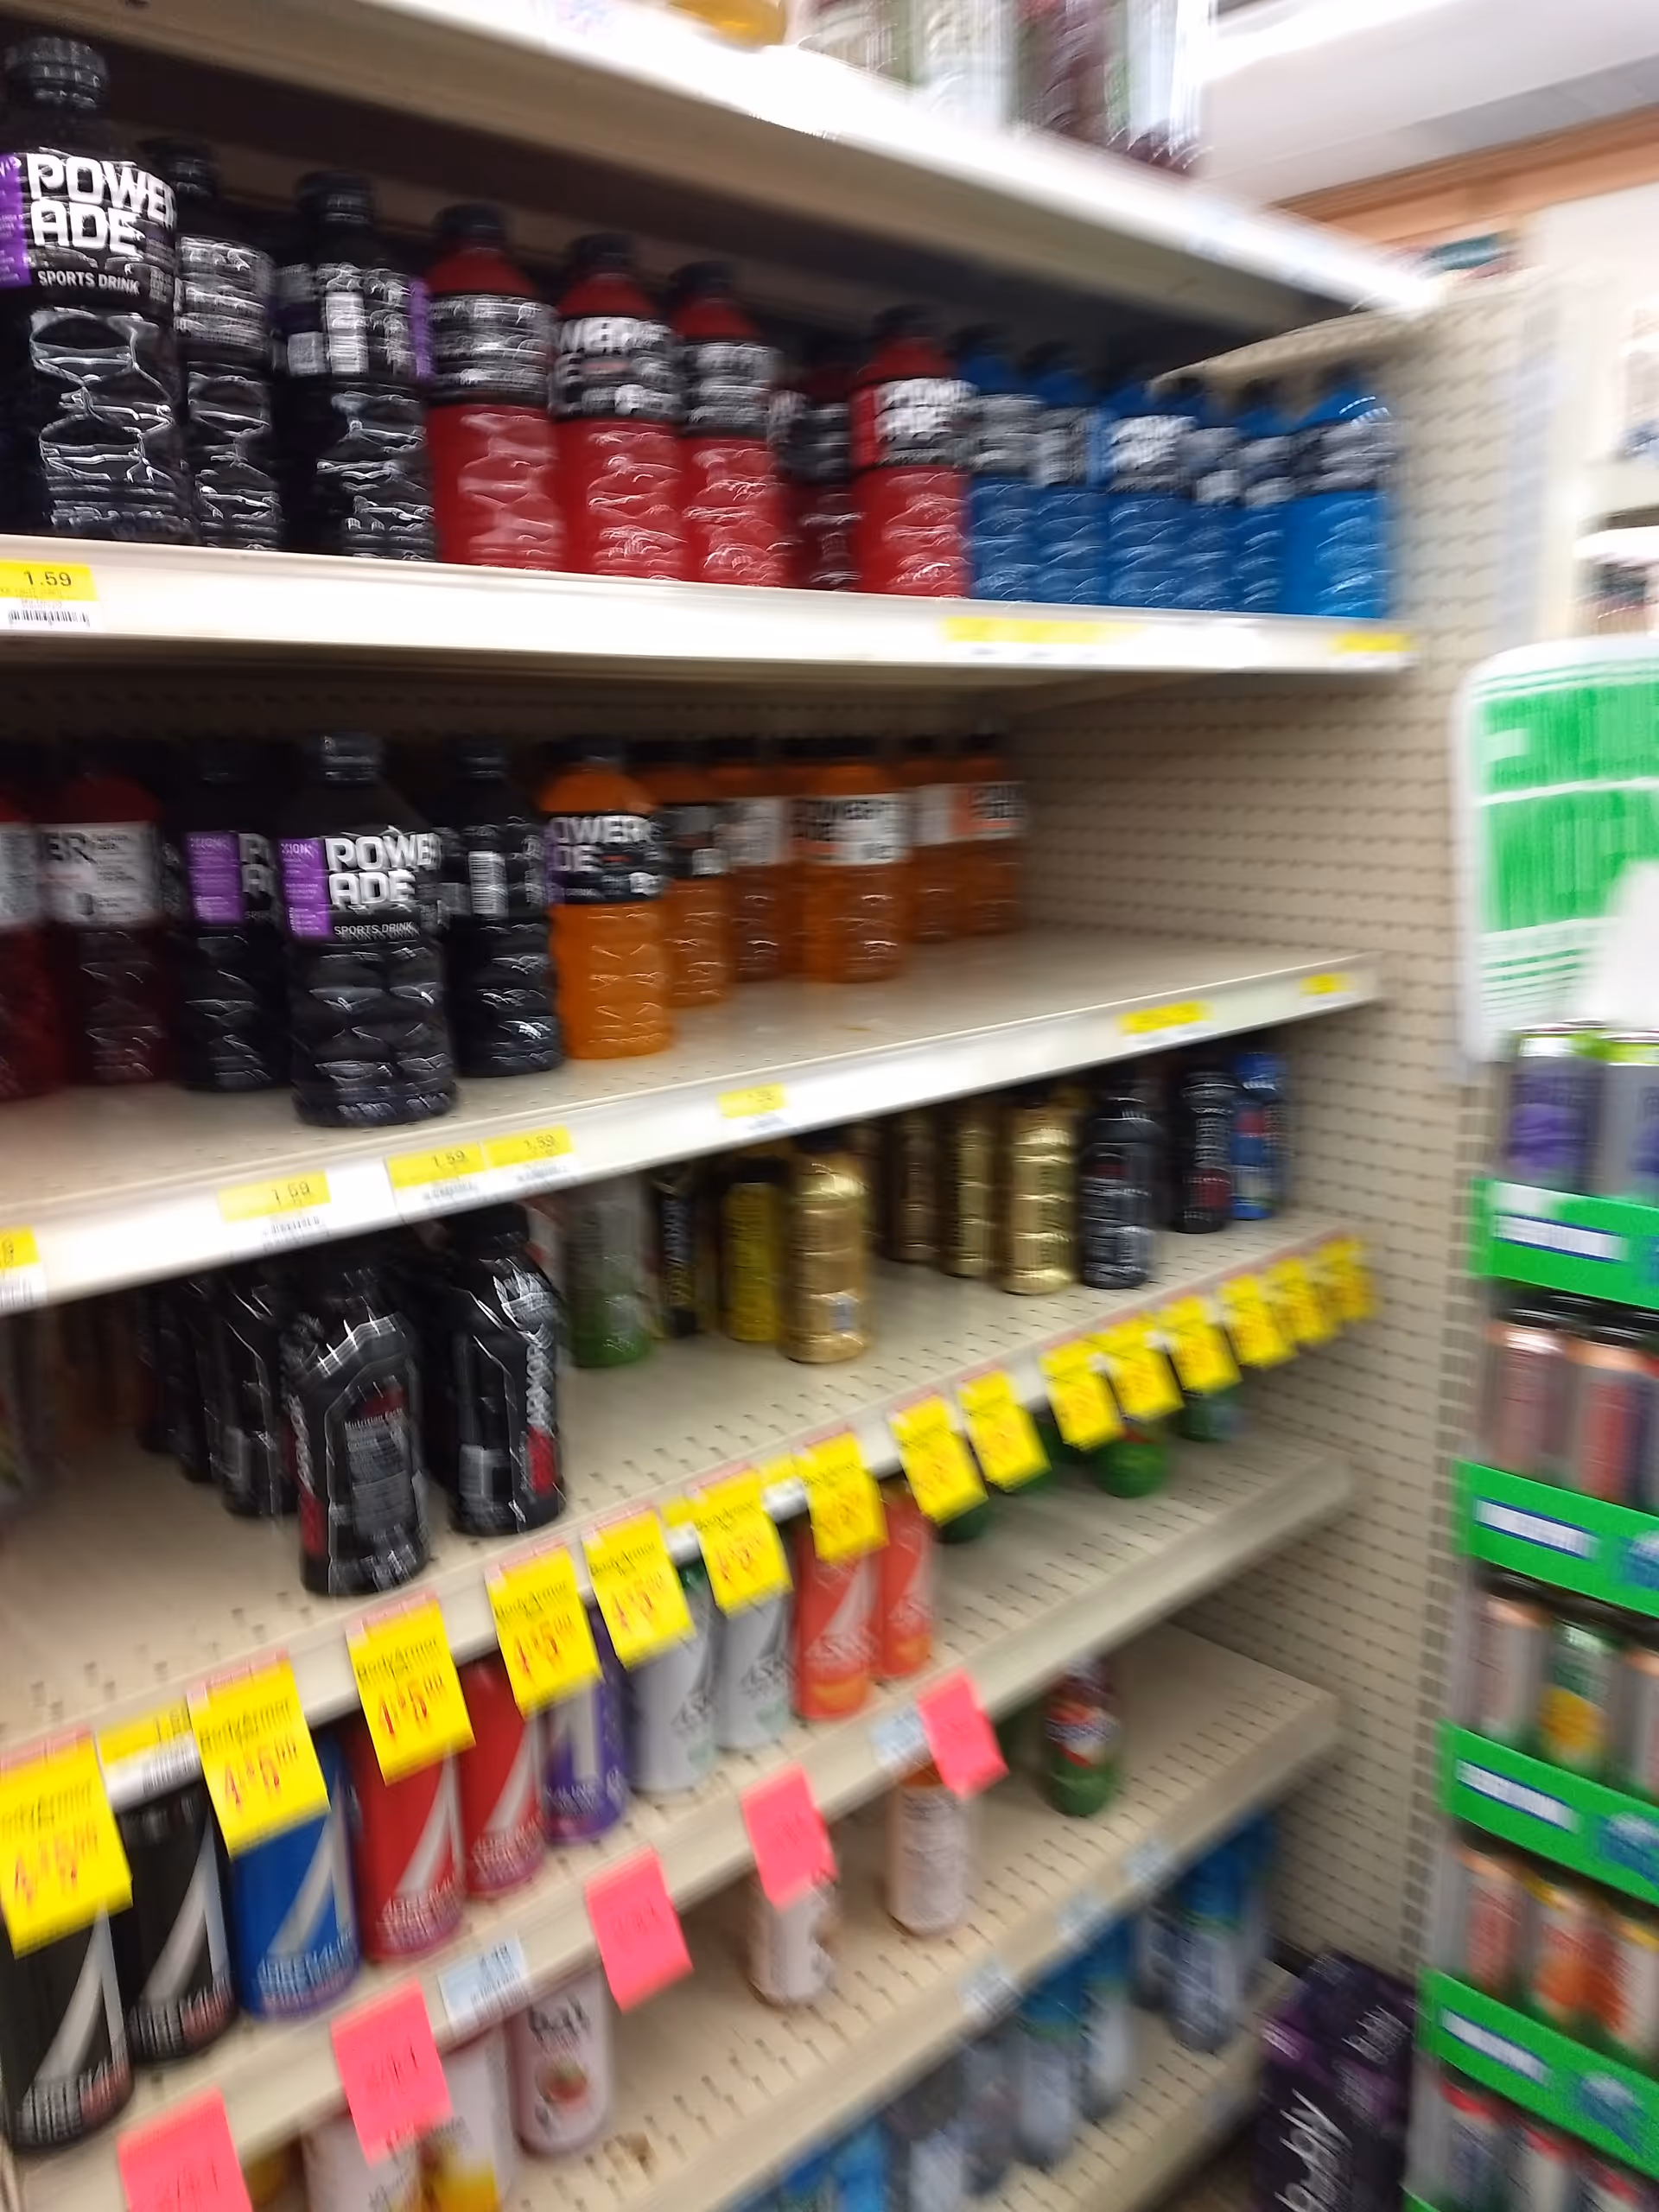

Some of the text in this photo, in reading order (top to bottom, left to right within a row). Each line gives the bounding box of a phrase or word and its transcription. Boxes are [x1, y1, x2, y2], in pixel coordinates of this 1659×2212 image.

[31, 200, 145, 261] ADE
[38, 270, 141, 296] SPORTS DRINK
[22, 570, 72, 587] 1.59
[328, 868, 416, 906] ADE
[334, 921, 416, 938] SPORTS DRINK
